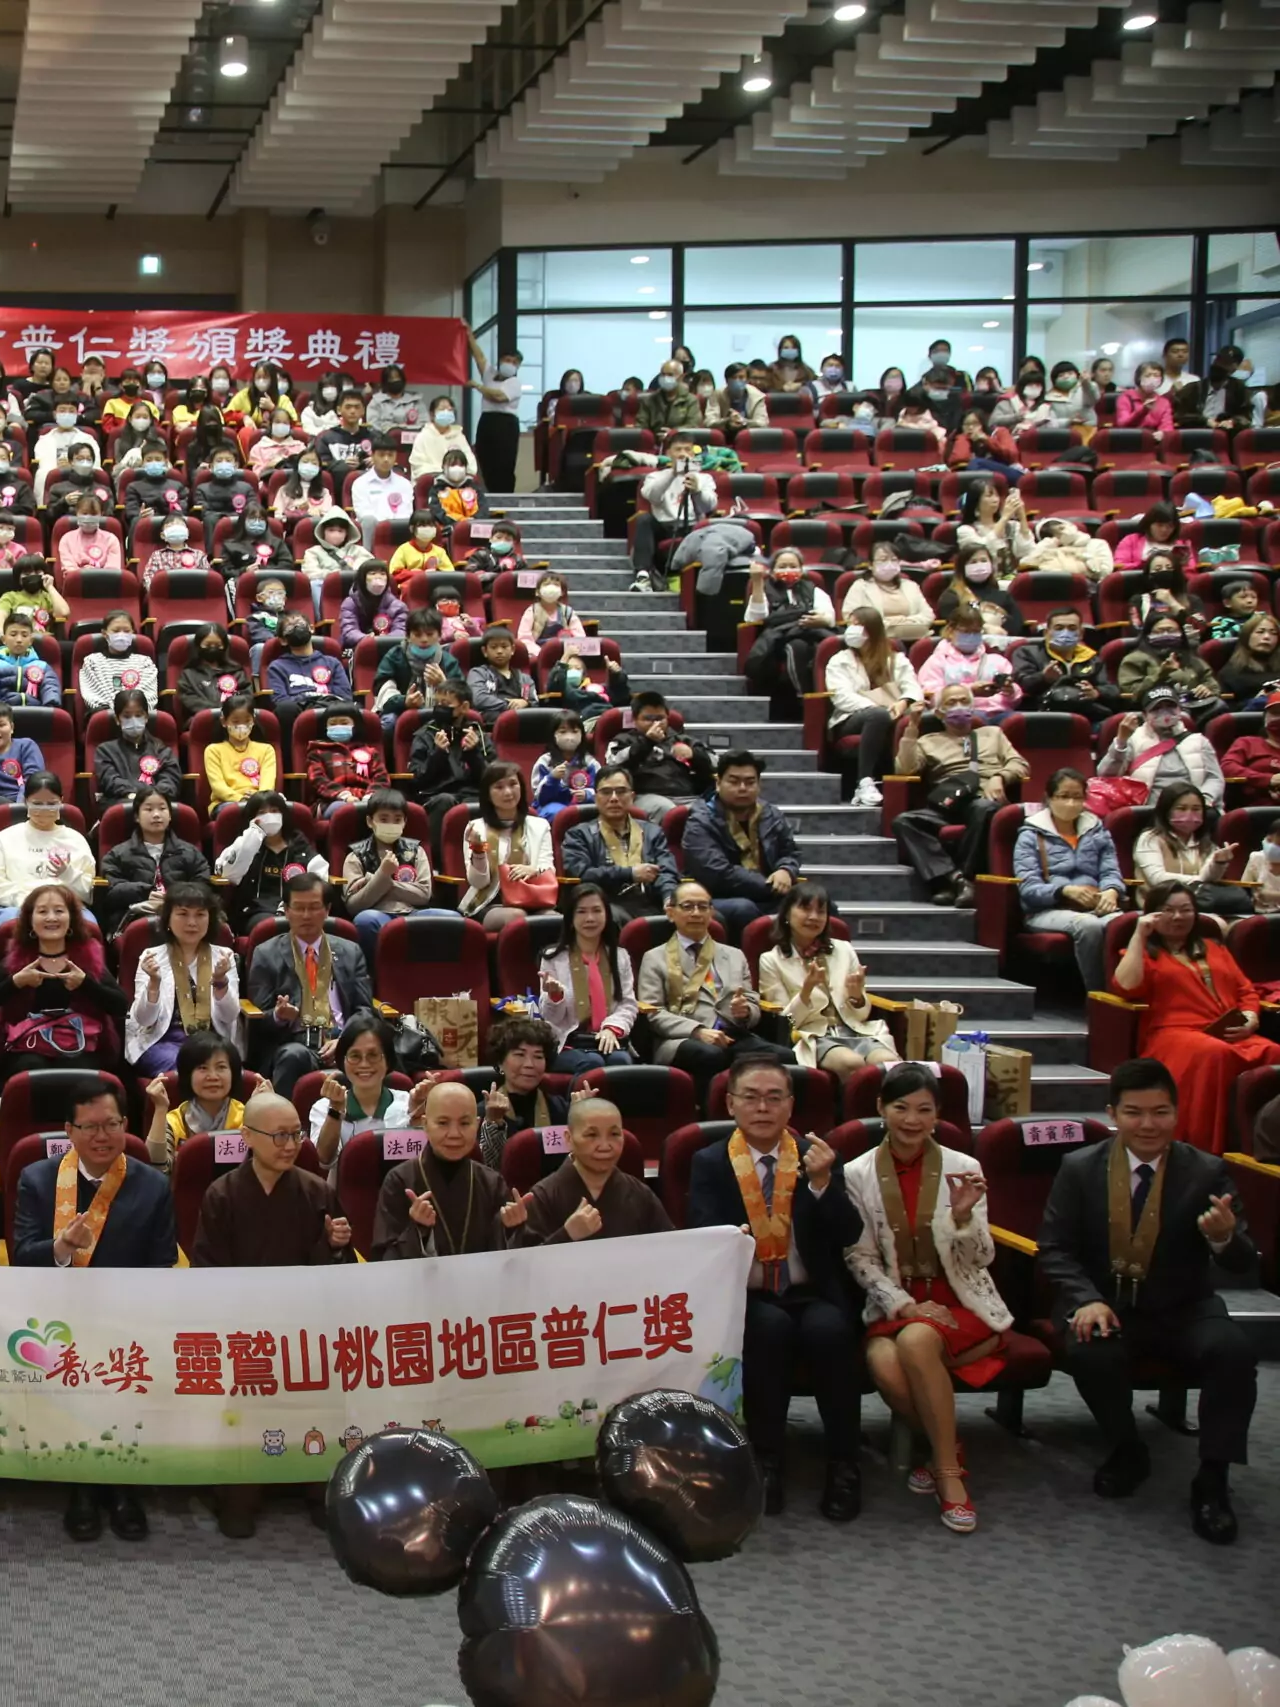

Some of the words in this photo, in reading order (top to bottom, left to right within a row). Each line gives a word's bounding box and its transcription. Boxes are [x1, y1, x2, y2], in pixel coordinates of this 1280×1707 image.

[387, 1138, 422, 1156] 法師
[1028, 1123, 1075, 1143] 貴賓席
[173, 1292, 694, 1397] 靈鷲山桃園地區普仁獎
[45, 1341, 154, 1394] 普仁獎
